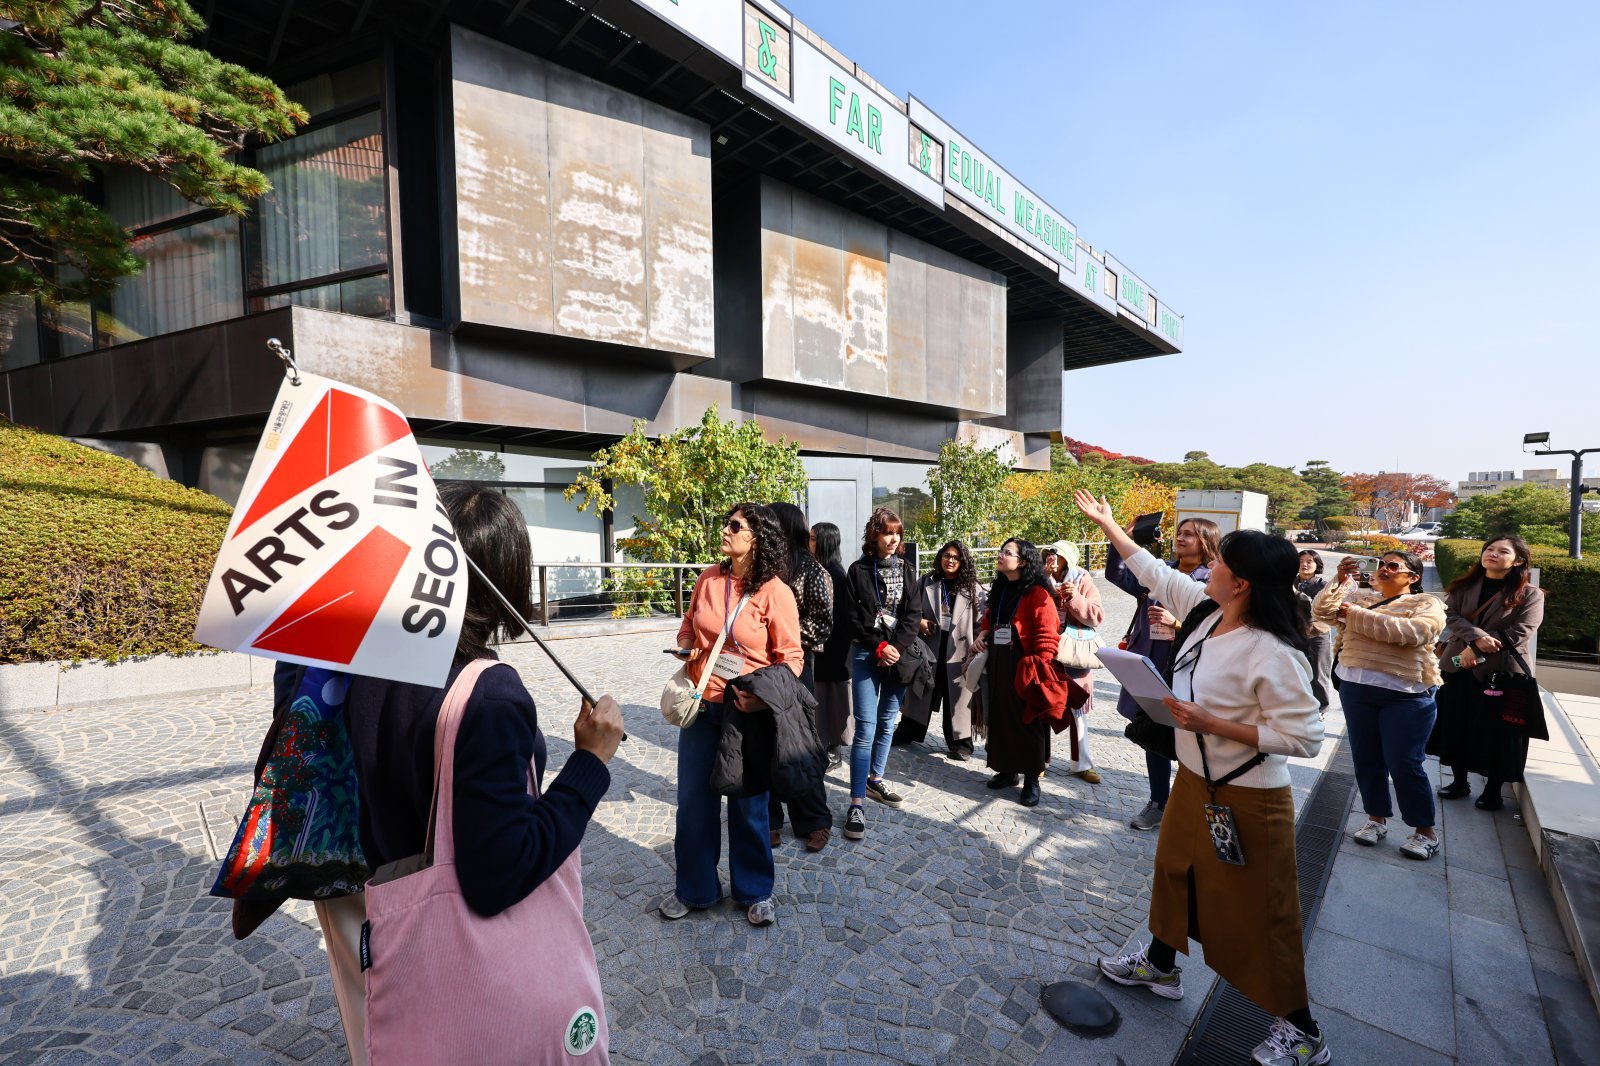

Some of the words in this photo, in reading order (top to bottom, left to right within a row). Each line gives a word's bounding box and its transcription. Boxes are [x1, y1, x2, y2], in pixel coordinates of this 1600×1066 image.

[757, 19, 777, 82] &
[828, 76, 882, 155] FAR
[918, 132, 932, 176] &
[948, 139, 1005, 216] EQUAL
[1014, 190, 1075, 263] MEASURE
[1084, 261, 1098, 294] AT
[1121, 273, 1145, 312] SOME
[372, 455, 418, 510] IN
[220, 489, 360, 617] ARTS
[401, 492, 459, 639] SEOU
